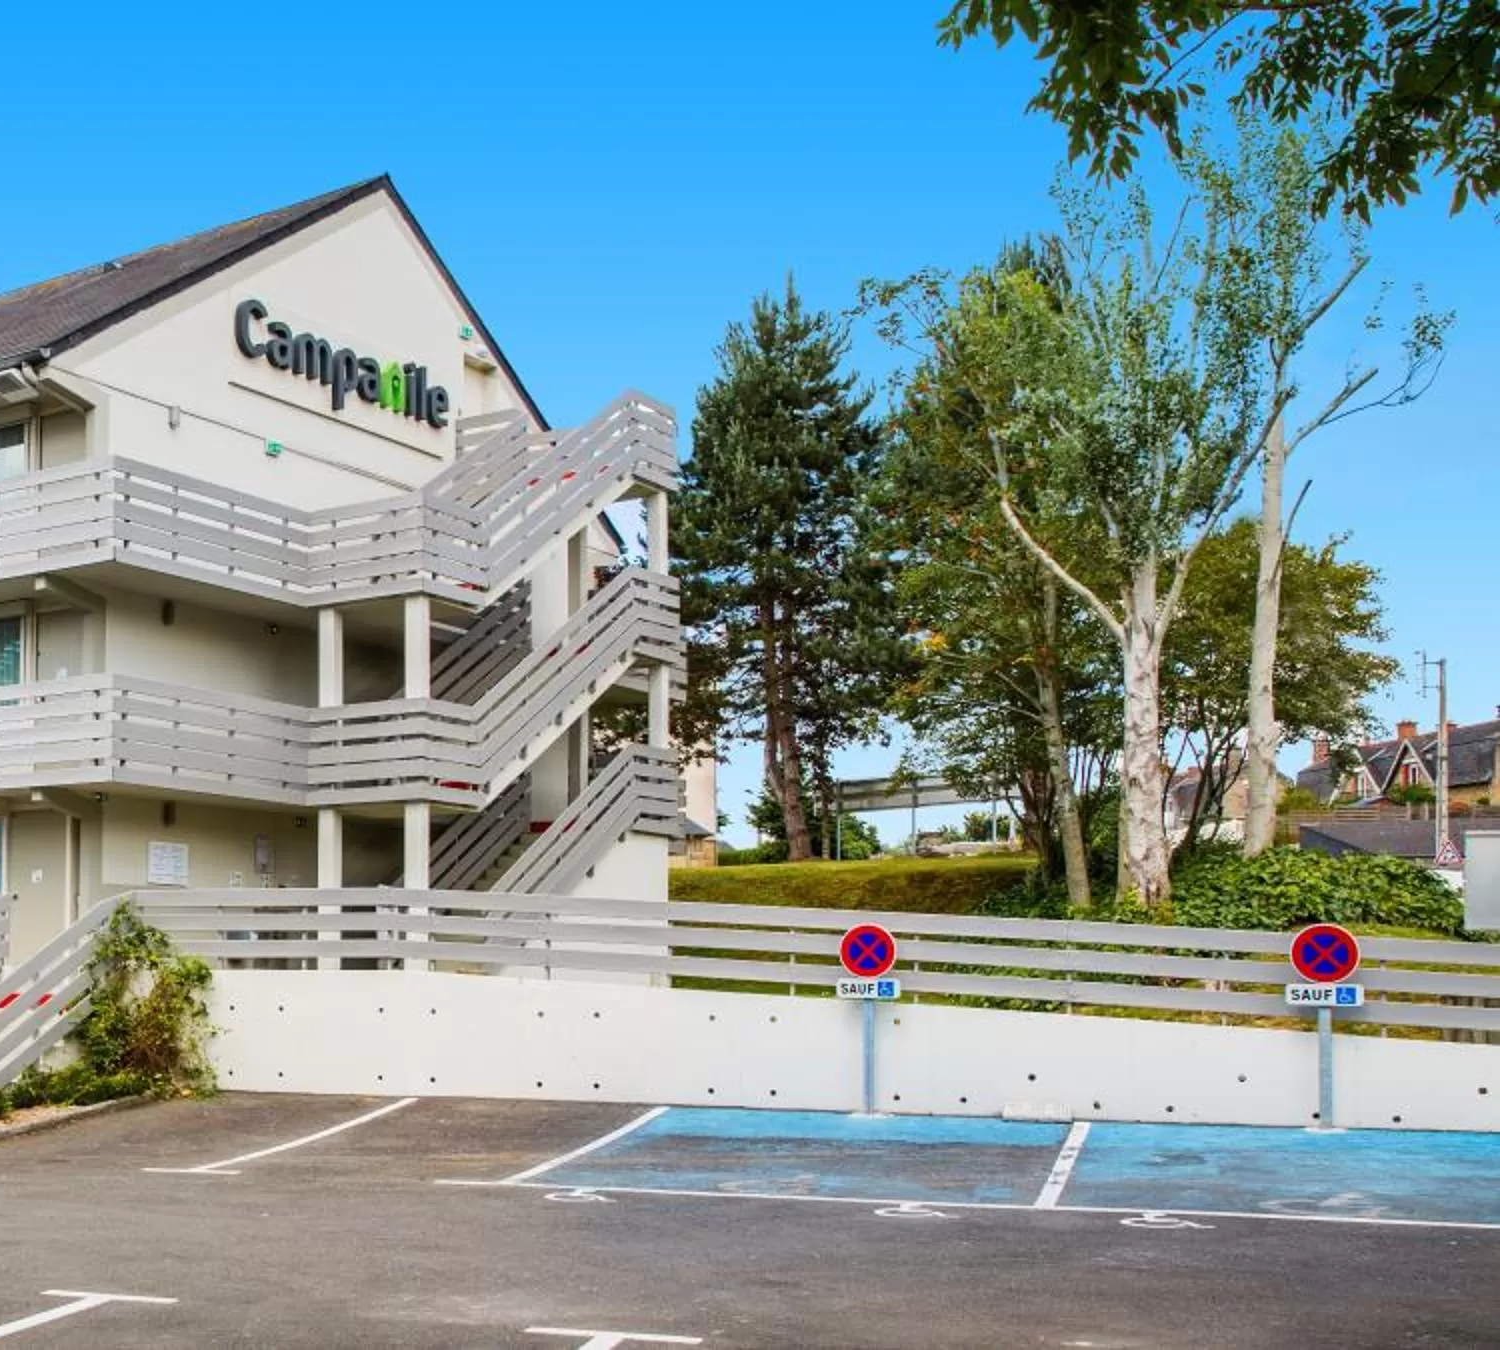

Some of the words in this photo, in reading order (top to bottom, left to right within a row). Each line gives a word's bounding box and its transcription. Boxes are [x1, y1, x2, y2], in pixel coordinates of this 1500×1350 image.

[235, 299, 449, 428] Campanile
[840, 983, 875, 995] SAUF
[1291, 989, 1333, 1001] SAUF
